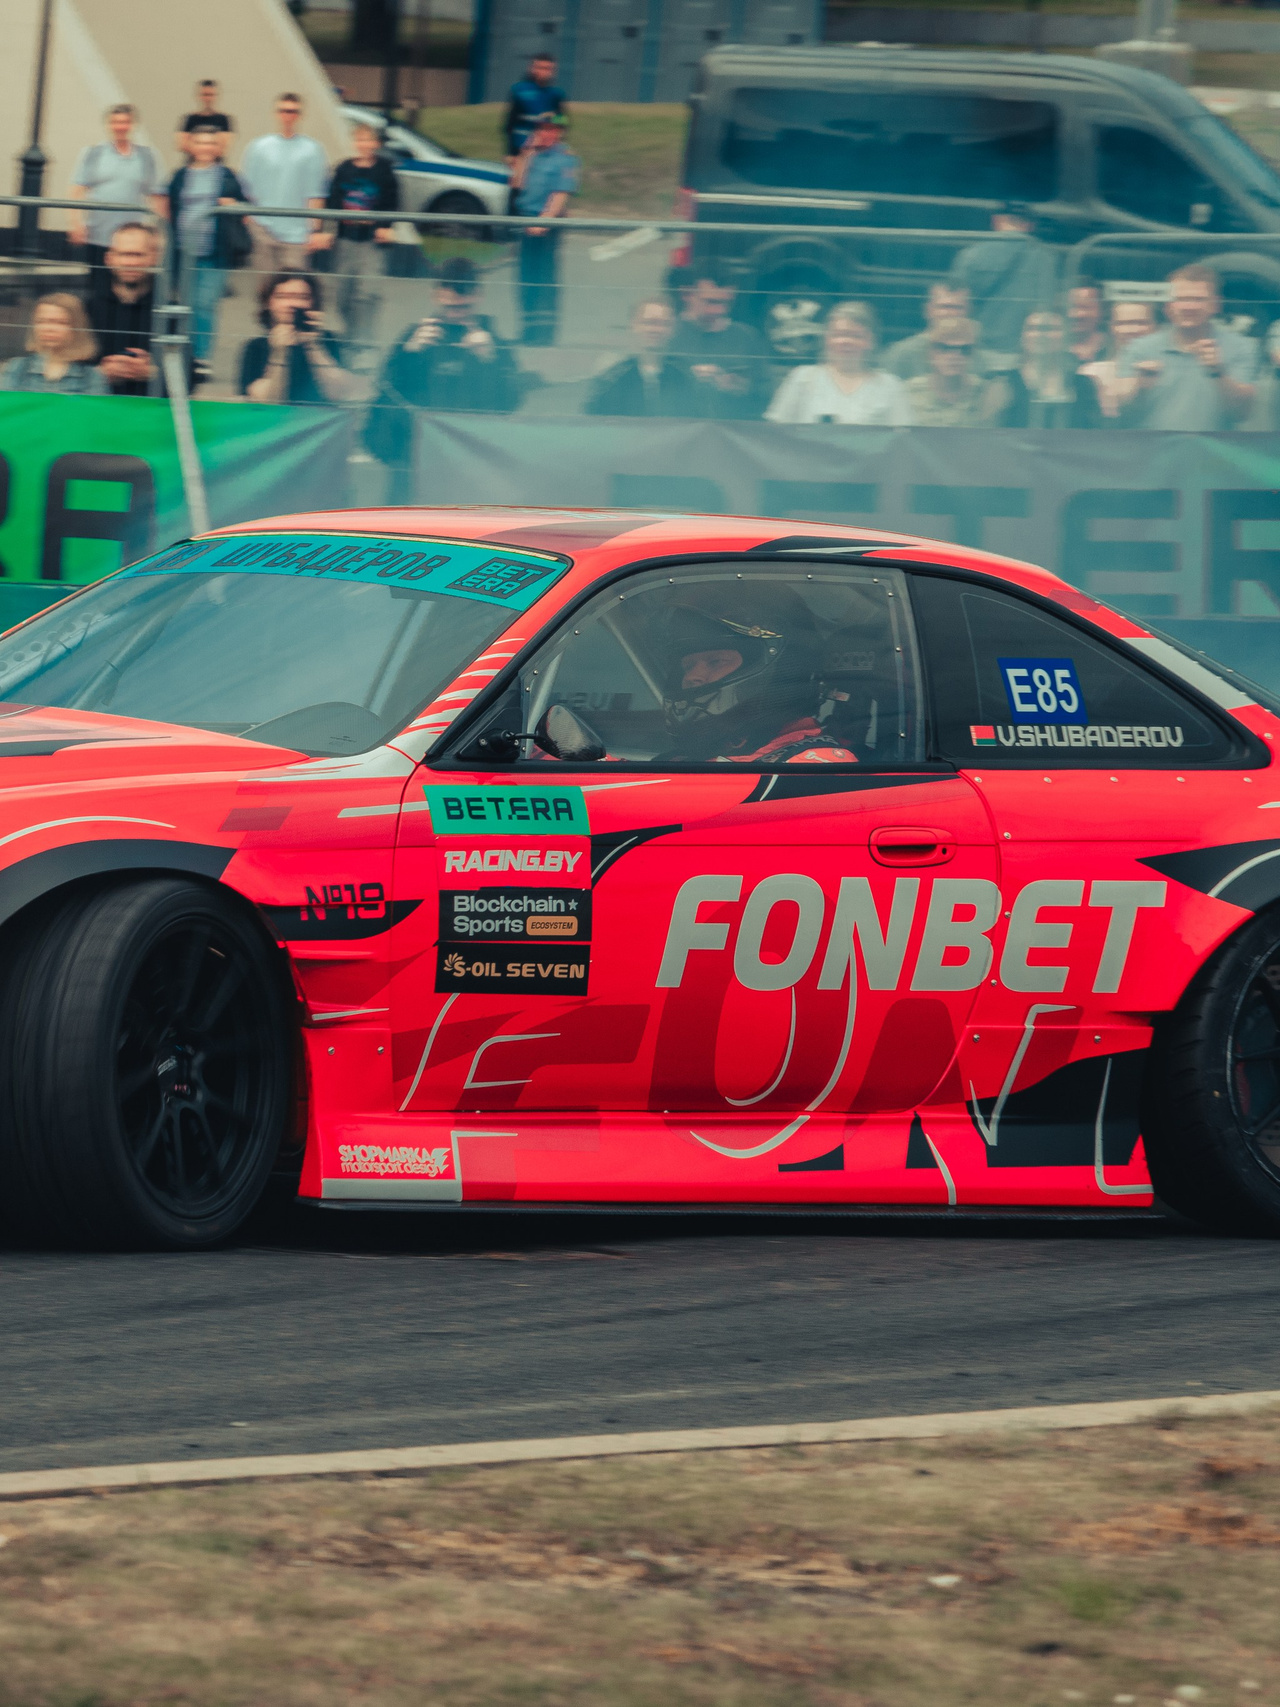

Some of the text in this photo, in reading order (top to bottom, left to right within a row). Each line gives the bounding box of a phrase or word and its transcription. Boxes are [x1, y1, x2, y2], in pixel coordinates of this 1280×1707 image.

[211, 541, 453, 581] ШУБАДЁРОВ
[477, 560, 544, 583] BET
[1005, 667, 1080, 714] E85
[997, 724, 1185, 748] V.SHUBADEROV
[444, 850, 584, 874] RACING.BY
[453, 895, 566, 913] Blockchain
[453, 915, 524, 936] Sports
[530, 921, 574, 930] ECOSYSTEM
[654, 873, 1169, 994] FONBET
[452, 961, 586, 979] S-OIL SEVEN
[340, 1160, 441, 1178] motorsport design
